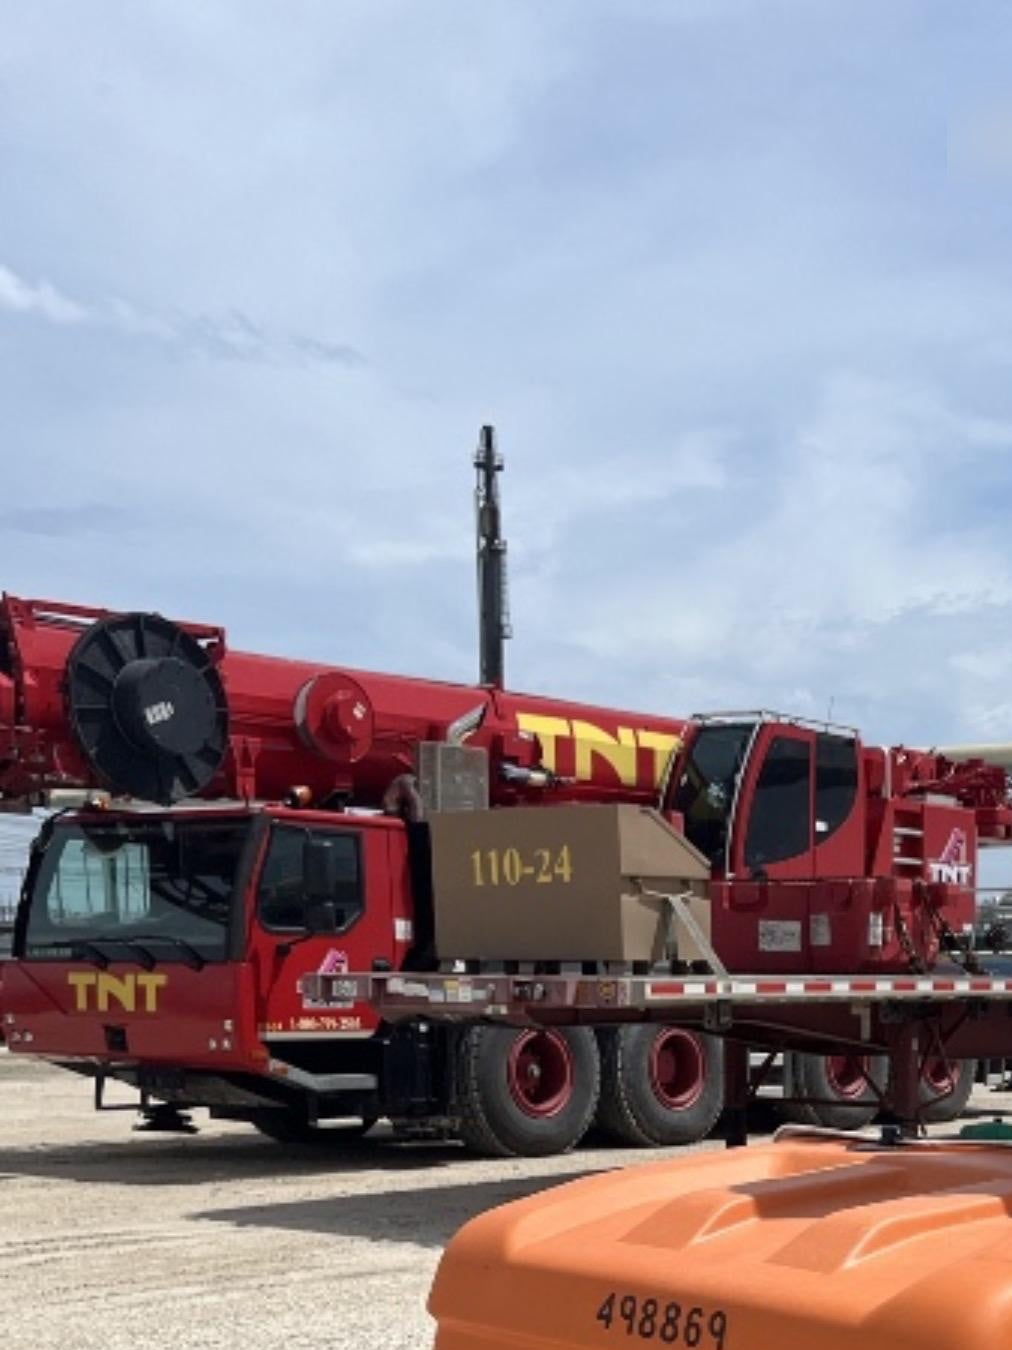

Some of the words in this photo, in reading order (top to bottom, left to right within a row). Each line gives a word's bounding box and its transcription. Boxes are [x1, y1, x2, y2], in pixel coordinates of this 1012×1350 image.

[516, 712, 683, 789] TNT
[470, 845, 573, 887] 110-24
[929, 863, 970, 885] TNT
[67, 971, 168, 1012] TNT
